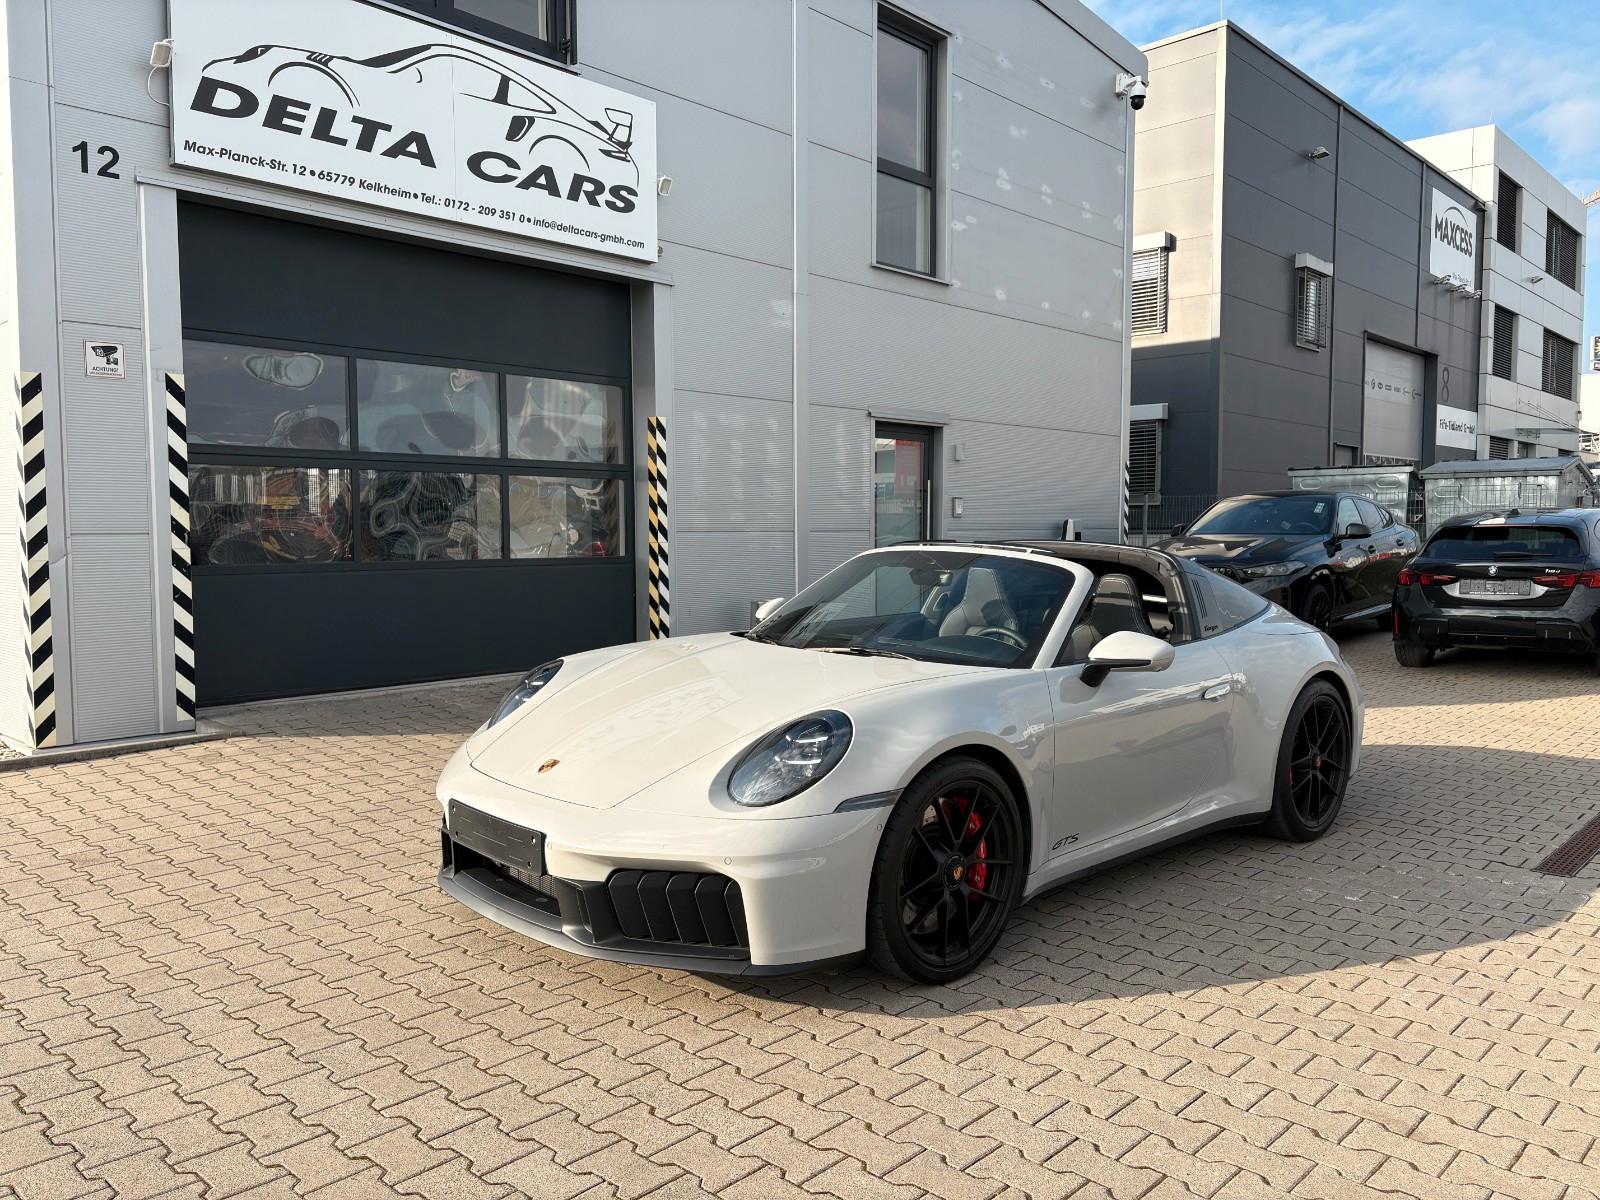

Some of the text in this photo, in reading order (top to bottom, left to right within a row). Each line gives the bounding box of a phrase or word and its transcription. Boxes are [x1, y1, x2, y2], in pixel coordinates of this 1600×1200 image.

[71, 140, 120, 179] 12
[190, 76, 639, 213] DELTA CARS
[184, 140, 289, 173] Max-Planck-Str.
[292, 164, 307, 177] 12
[317, 170, 356, 186] 65779
[358, 179, 412, 199] Kelkheim
[420, 192, 442, 205] Tel.:
[444, 197, 470, 211] 0172
[478, 205, 497, 217] 209
[499, 209, 516, 222] 351
[519, 214, 526, 223] 0
[532, 217, 645, 249] info@deltacars-gmbh.com
[1434, 212, 1473, 258] MAXCESS
[1441, 367, 1450, 401] 8
[1052, 832, 1080, 850] GTS
